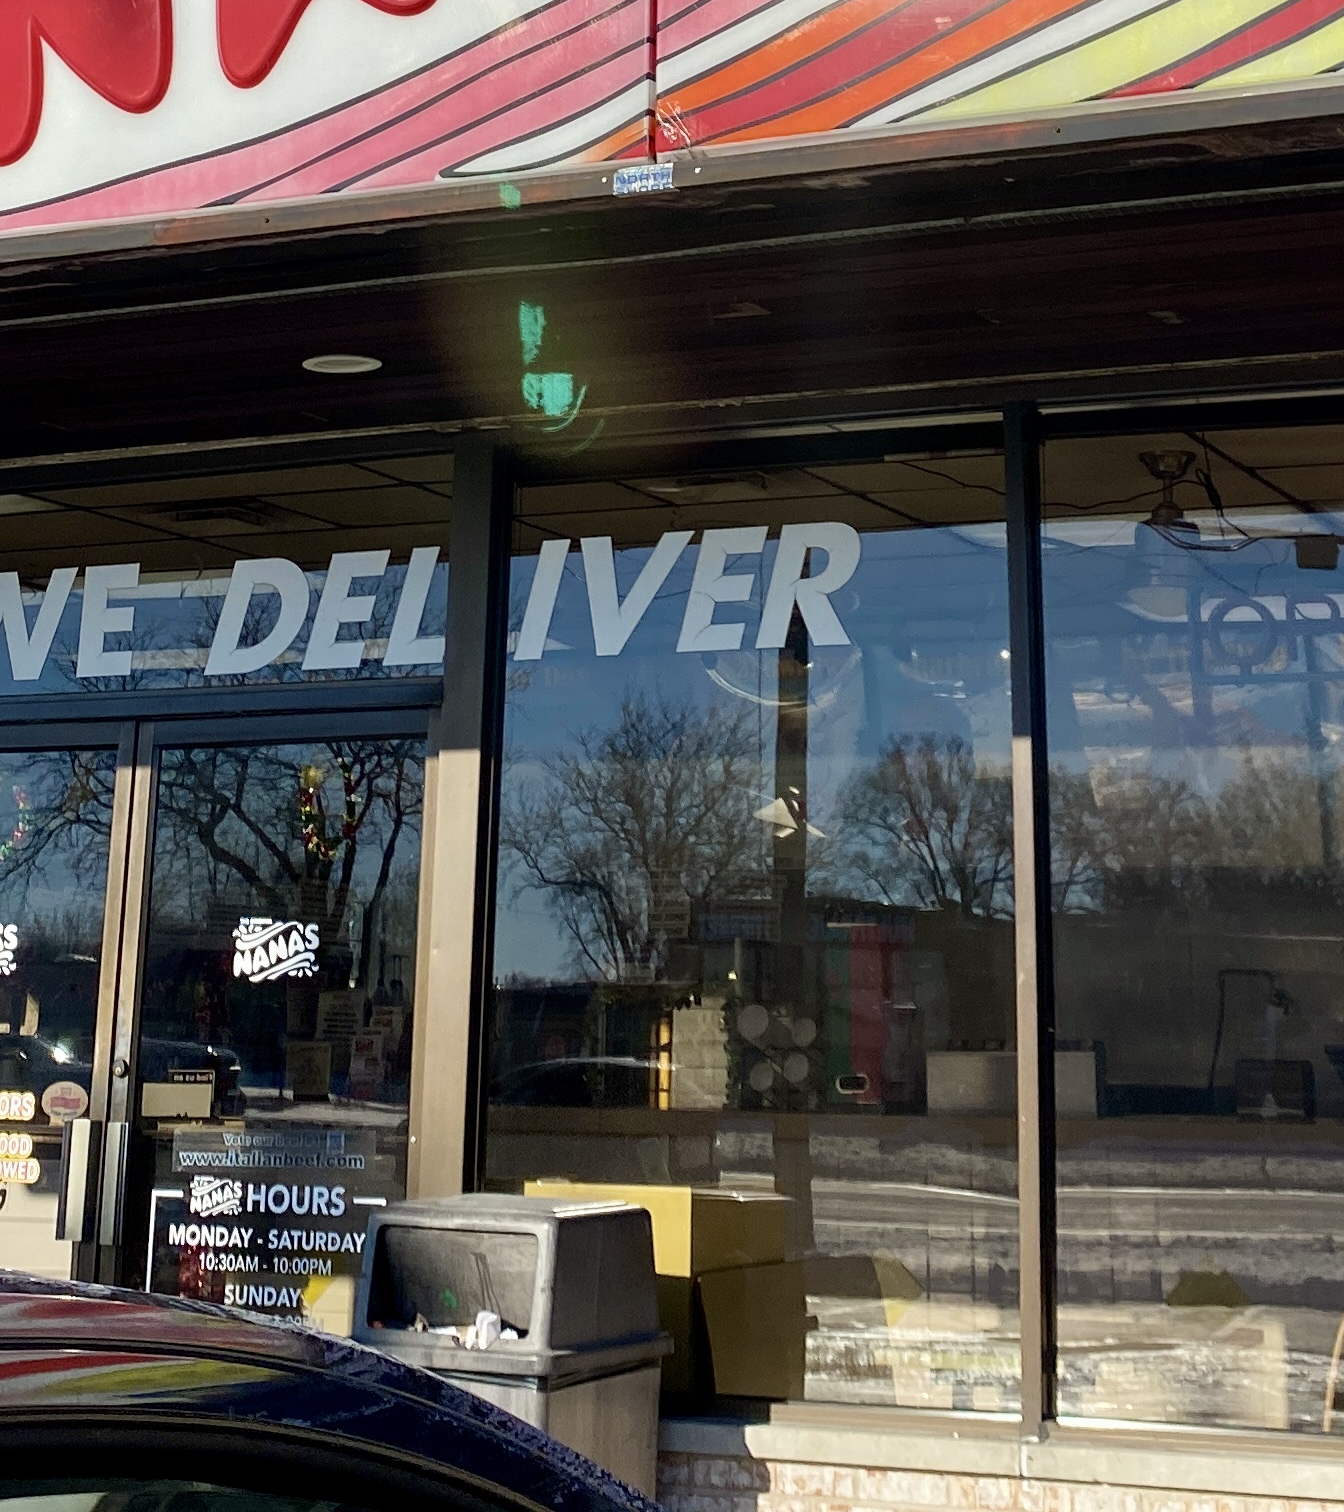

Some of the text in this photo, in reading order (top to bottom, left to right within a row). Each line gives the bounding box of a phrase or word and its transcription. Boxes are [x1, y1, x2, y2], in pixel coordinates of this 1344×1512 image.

[246, 1184, 346, 1217] HOURS
[168, 1223, 254, 1249] MONDAY
[267, 1228, 366, 1253] SATURDAY
[199, 1254, 259, 1273] 10:30AM
[273, 1257, 333, 1276] 10:00PM
[223, 1284, 302, 1308] SUNDAY
